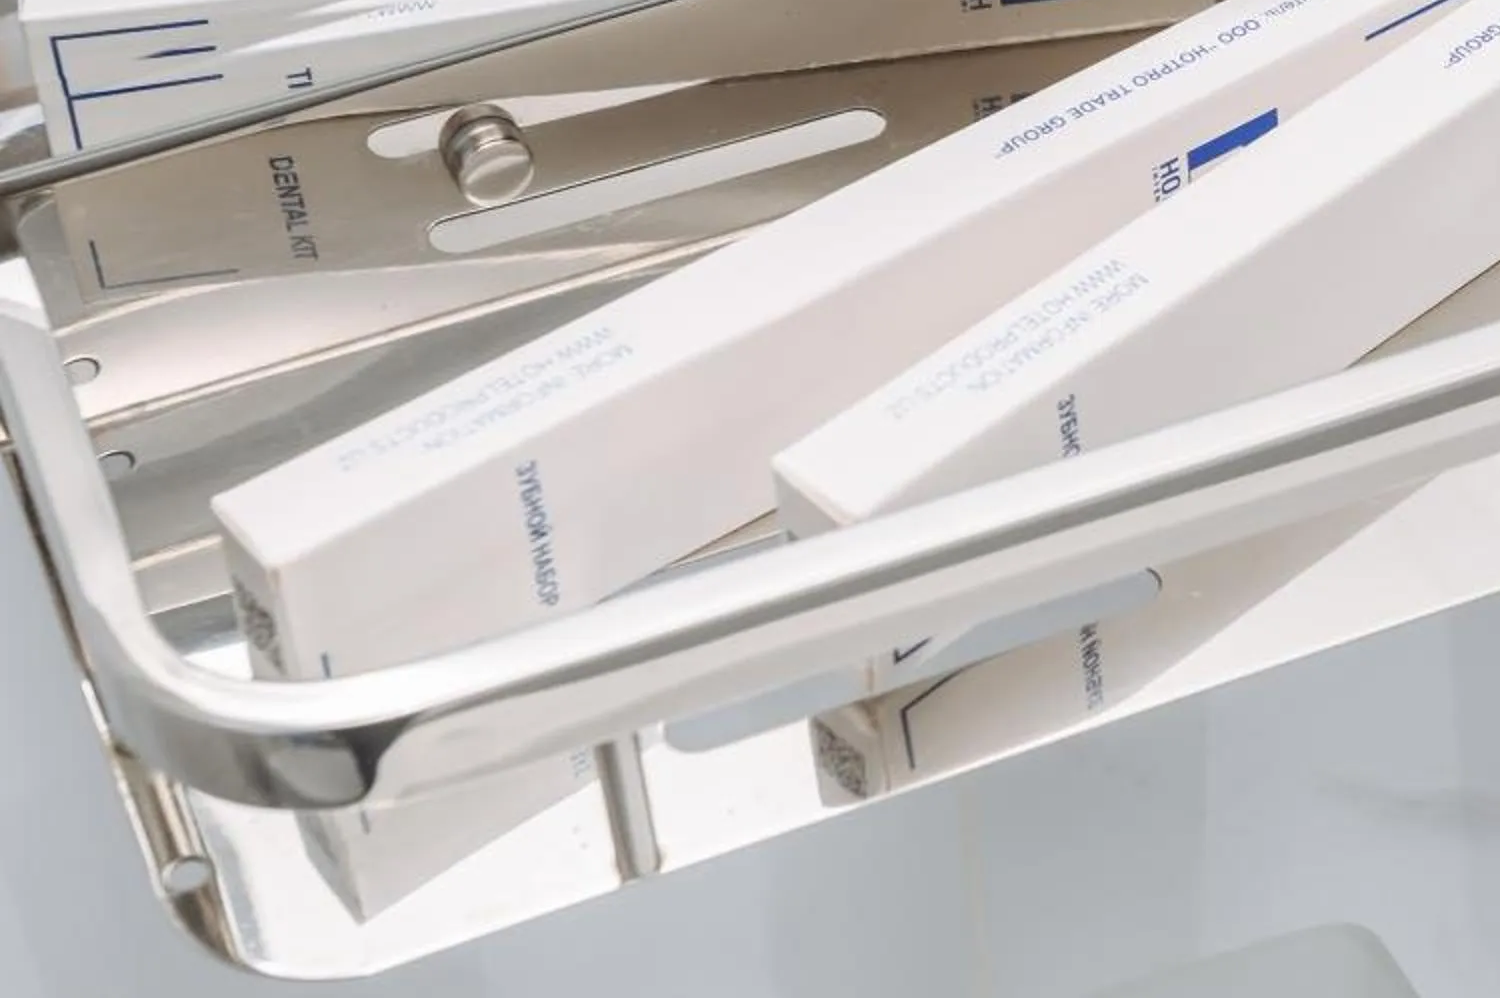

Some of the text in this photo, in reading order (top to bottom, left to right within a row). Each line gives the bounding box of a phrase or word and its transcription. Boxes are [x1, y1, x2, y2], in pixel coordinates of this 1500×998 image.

[1066, 83, 1133, 120] TRADE
[268, 155, 309, 233] DENTAL
[530, 542, 560, 607] НАБОР
